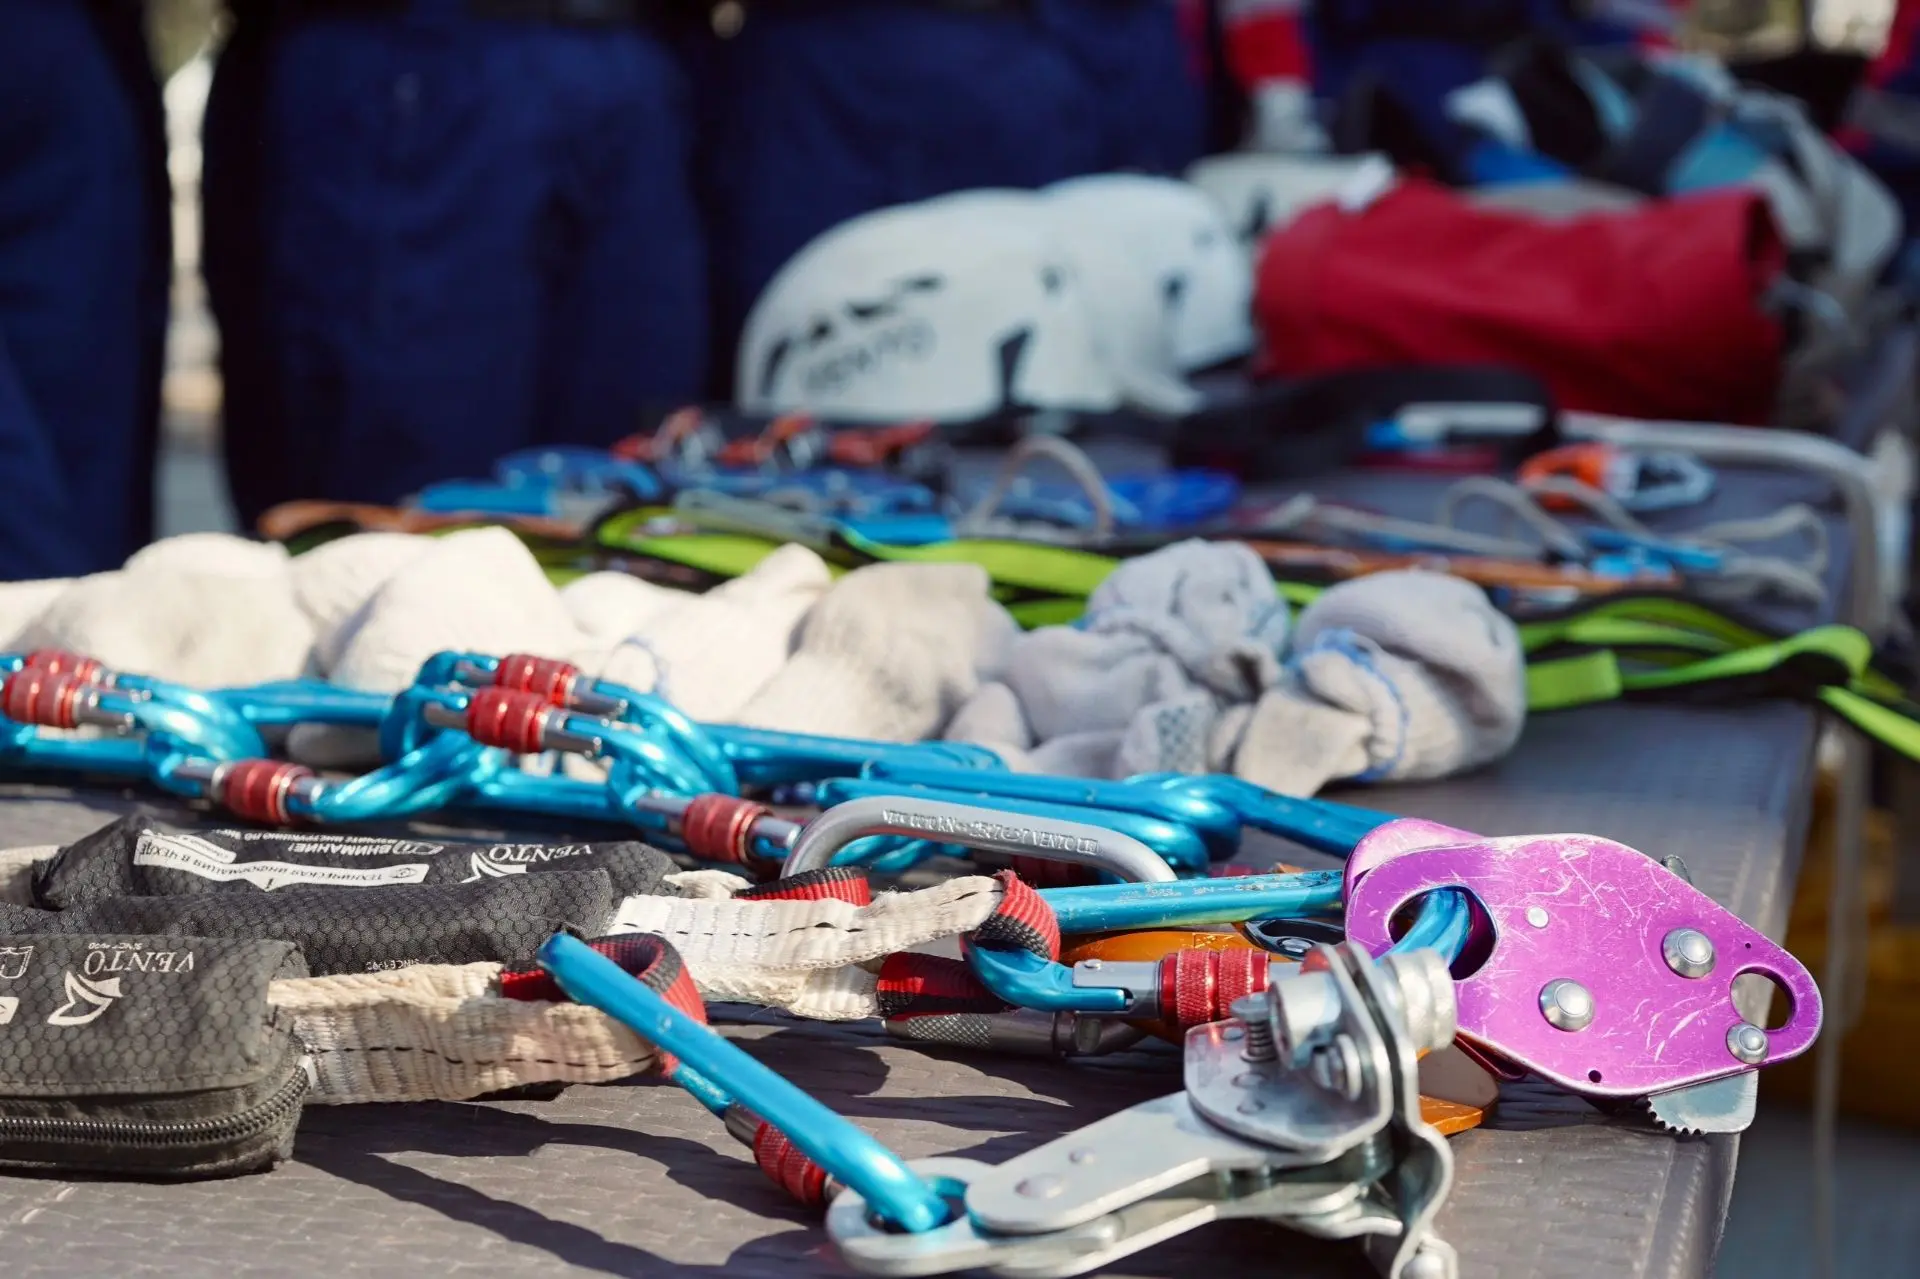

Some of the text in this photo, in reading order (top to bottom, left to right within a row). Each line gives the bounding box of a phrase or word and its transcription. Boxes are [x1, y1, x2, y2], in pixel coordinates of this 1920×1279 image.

[288, 842, 392, 856] ВНИМАНИЕ!
[1032, 830, 1074, 851] VENTO
[139, 840, 178, 860] ЧЕХЛЕ
[488, 845, 592, 862] VENTO
[193, 859, 288, 876] ИНФОРМАЦИЯ
[291, 868, 382, 881] ТЕХНИЧЕСКАЯ
[84, 950, 194, 976] VENTO
